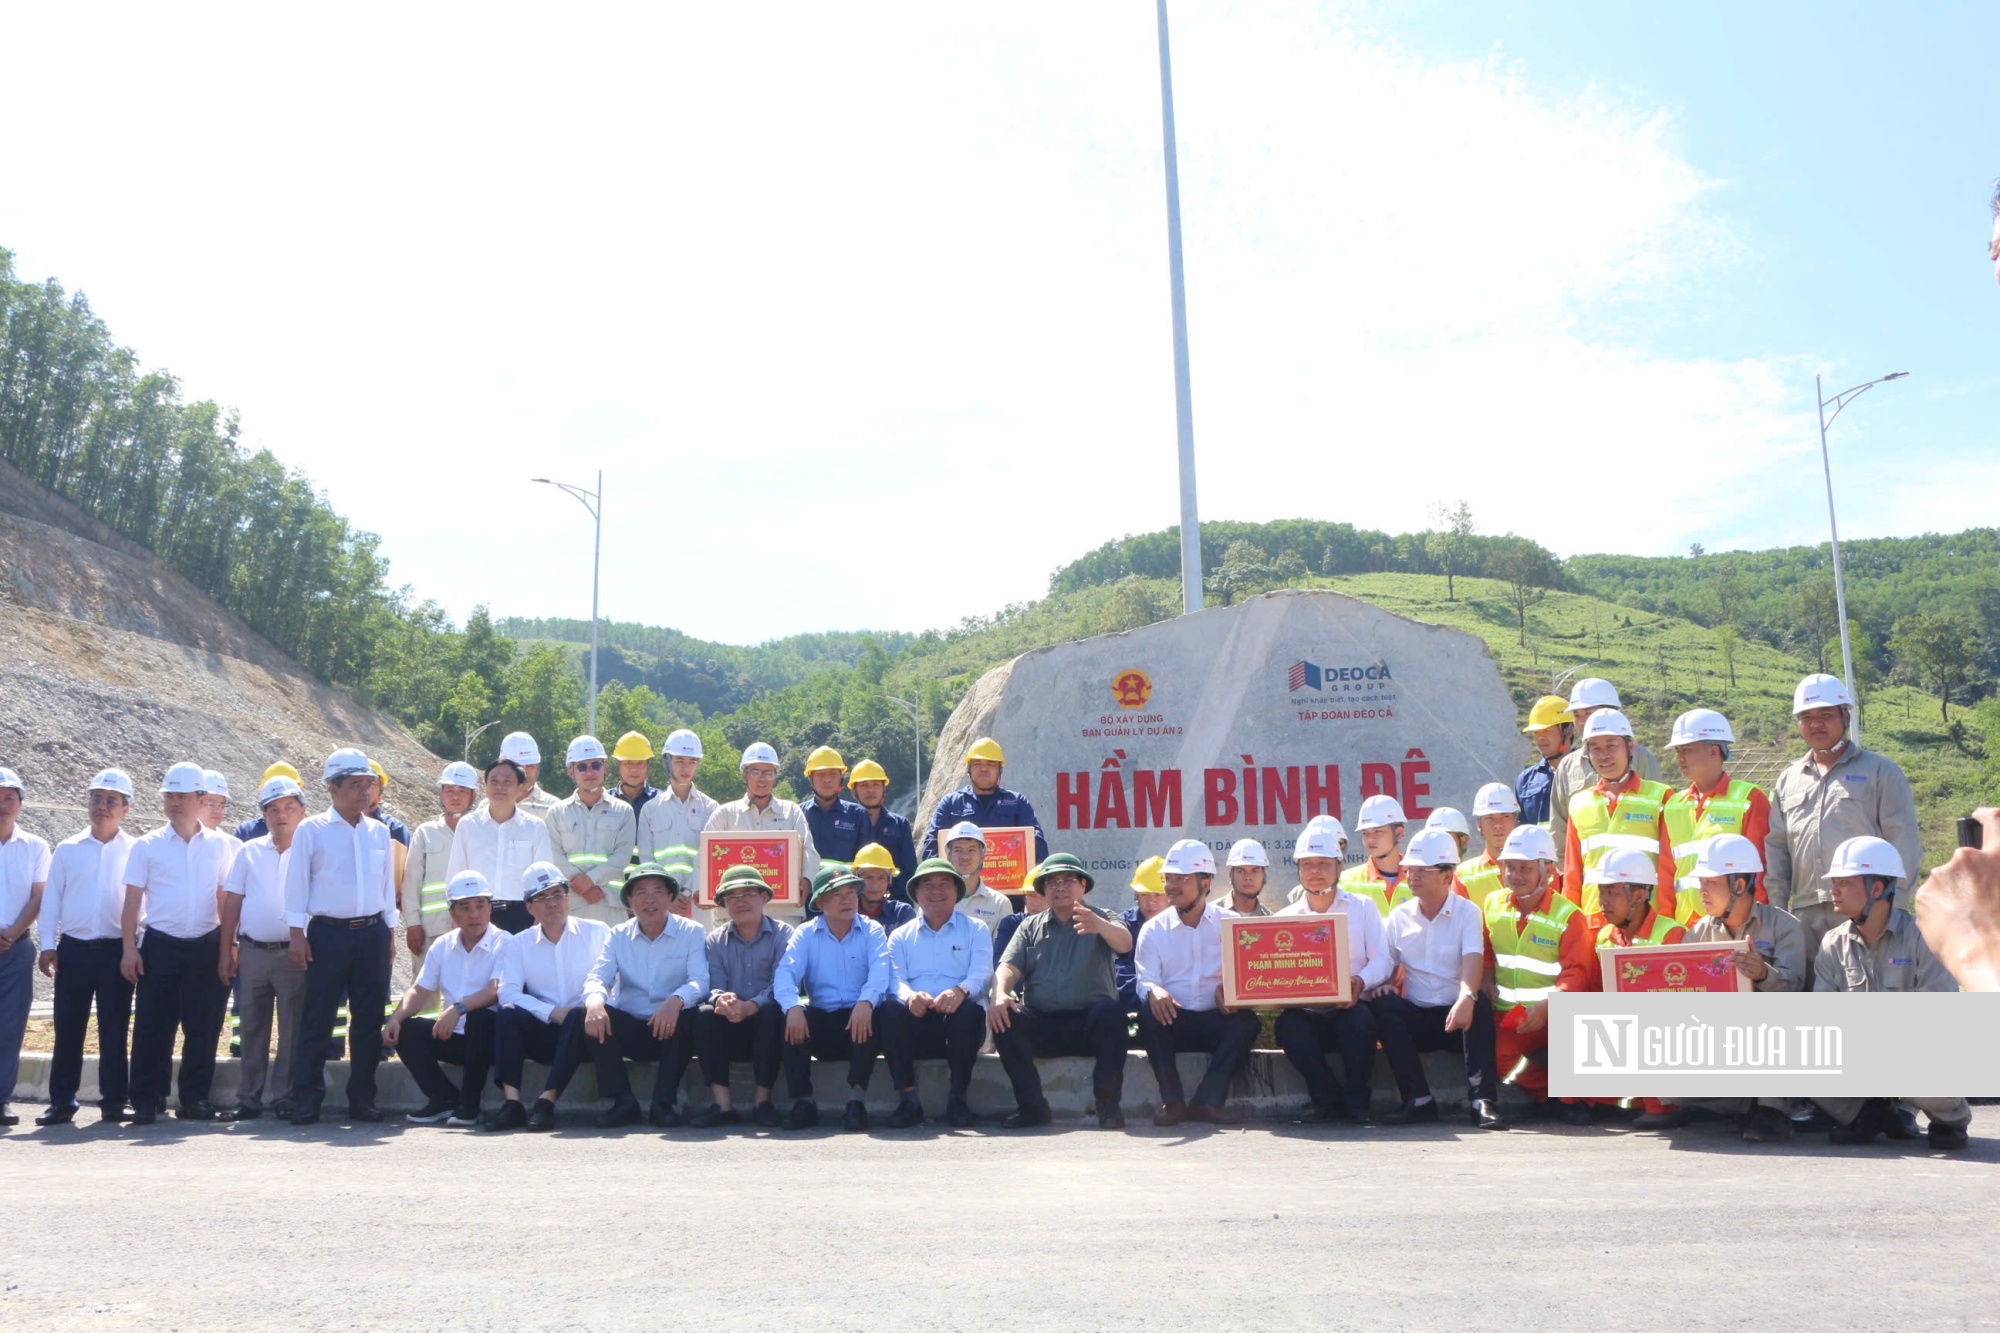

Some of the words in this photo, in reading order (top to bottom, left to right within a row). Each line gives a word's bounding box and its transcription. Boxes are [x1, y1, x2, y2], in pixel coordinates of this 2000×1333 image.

[1324, 666, 1392, 682] DEOCA
[1331, 683, 1385, 692] GROUP
[1100, 714, 1114, 725] BỘ
[1116, 713, 1134, 724] XÂY
[1137, 714, 1164, 724] DỰNG
[1298, 710, 1318, 722] TẬP
[1321, 709, 1351, 720] ĐOÀN
[1353, 708, 1375, 719] ĐÈO
[1378, 705, 1393, 718] CẢ
[1082, 728, 1101, 737] BAN
[1104, 725, 1130, 737] QUẢN
[1132, 726, 1144, 736] LÝ
[1147, 727, 1160, 737] DỰ
[1178, 726, 1183, 735] 2
[1056, 748, 1183, 830] HẦM
[1203, 754, 1342, 827] BÌNH
[1359, 747, 1434, 820] ĐÊ
[1091, 857, 1131, 870] CÔNG:
[1247, 960, 1272, 972] PHẠM
[1274, 959, 1296, 969] MINH
[1298, 957, 1323, 968] CHÍNH
